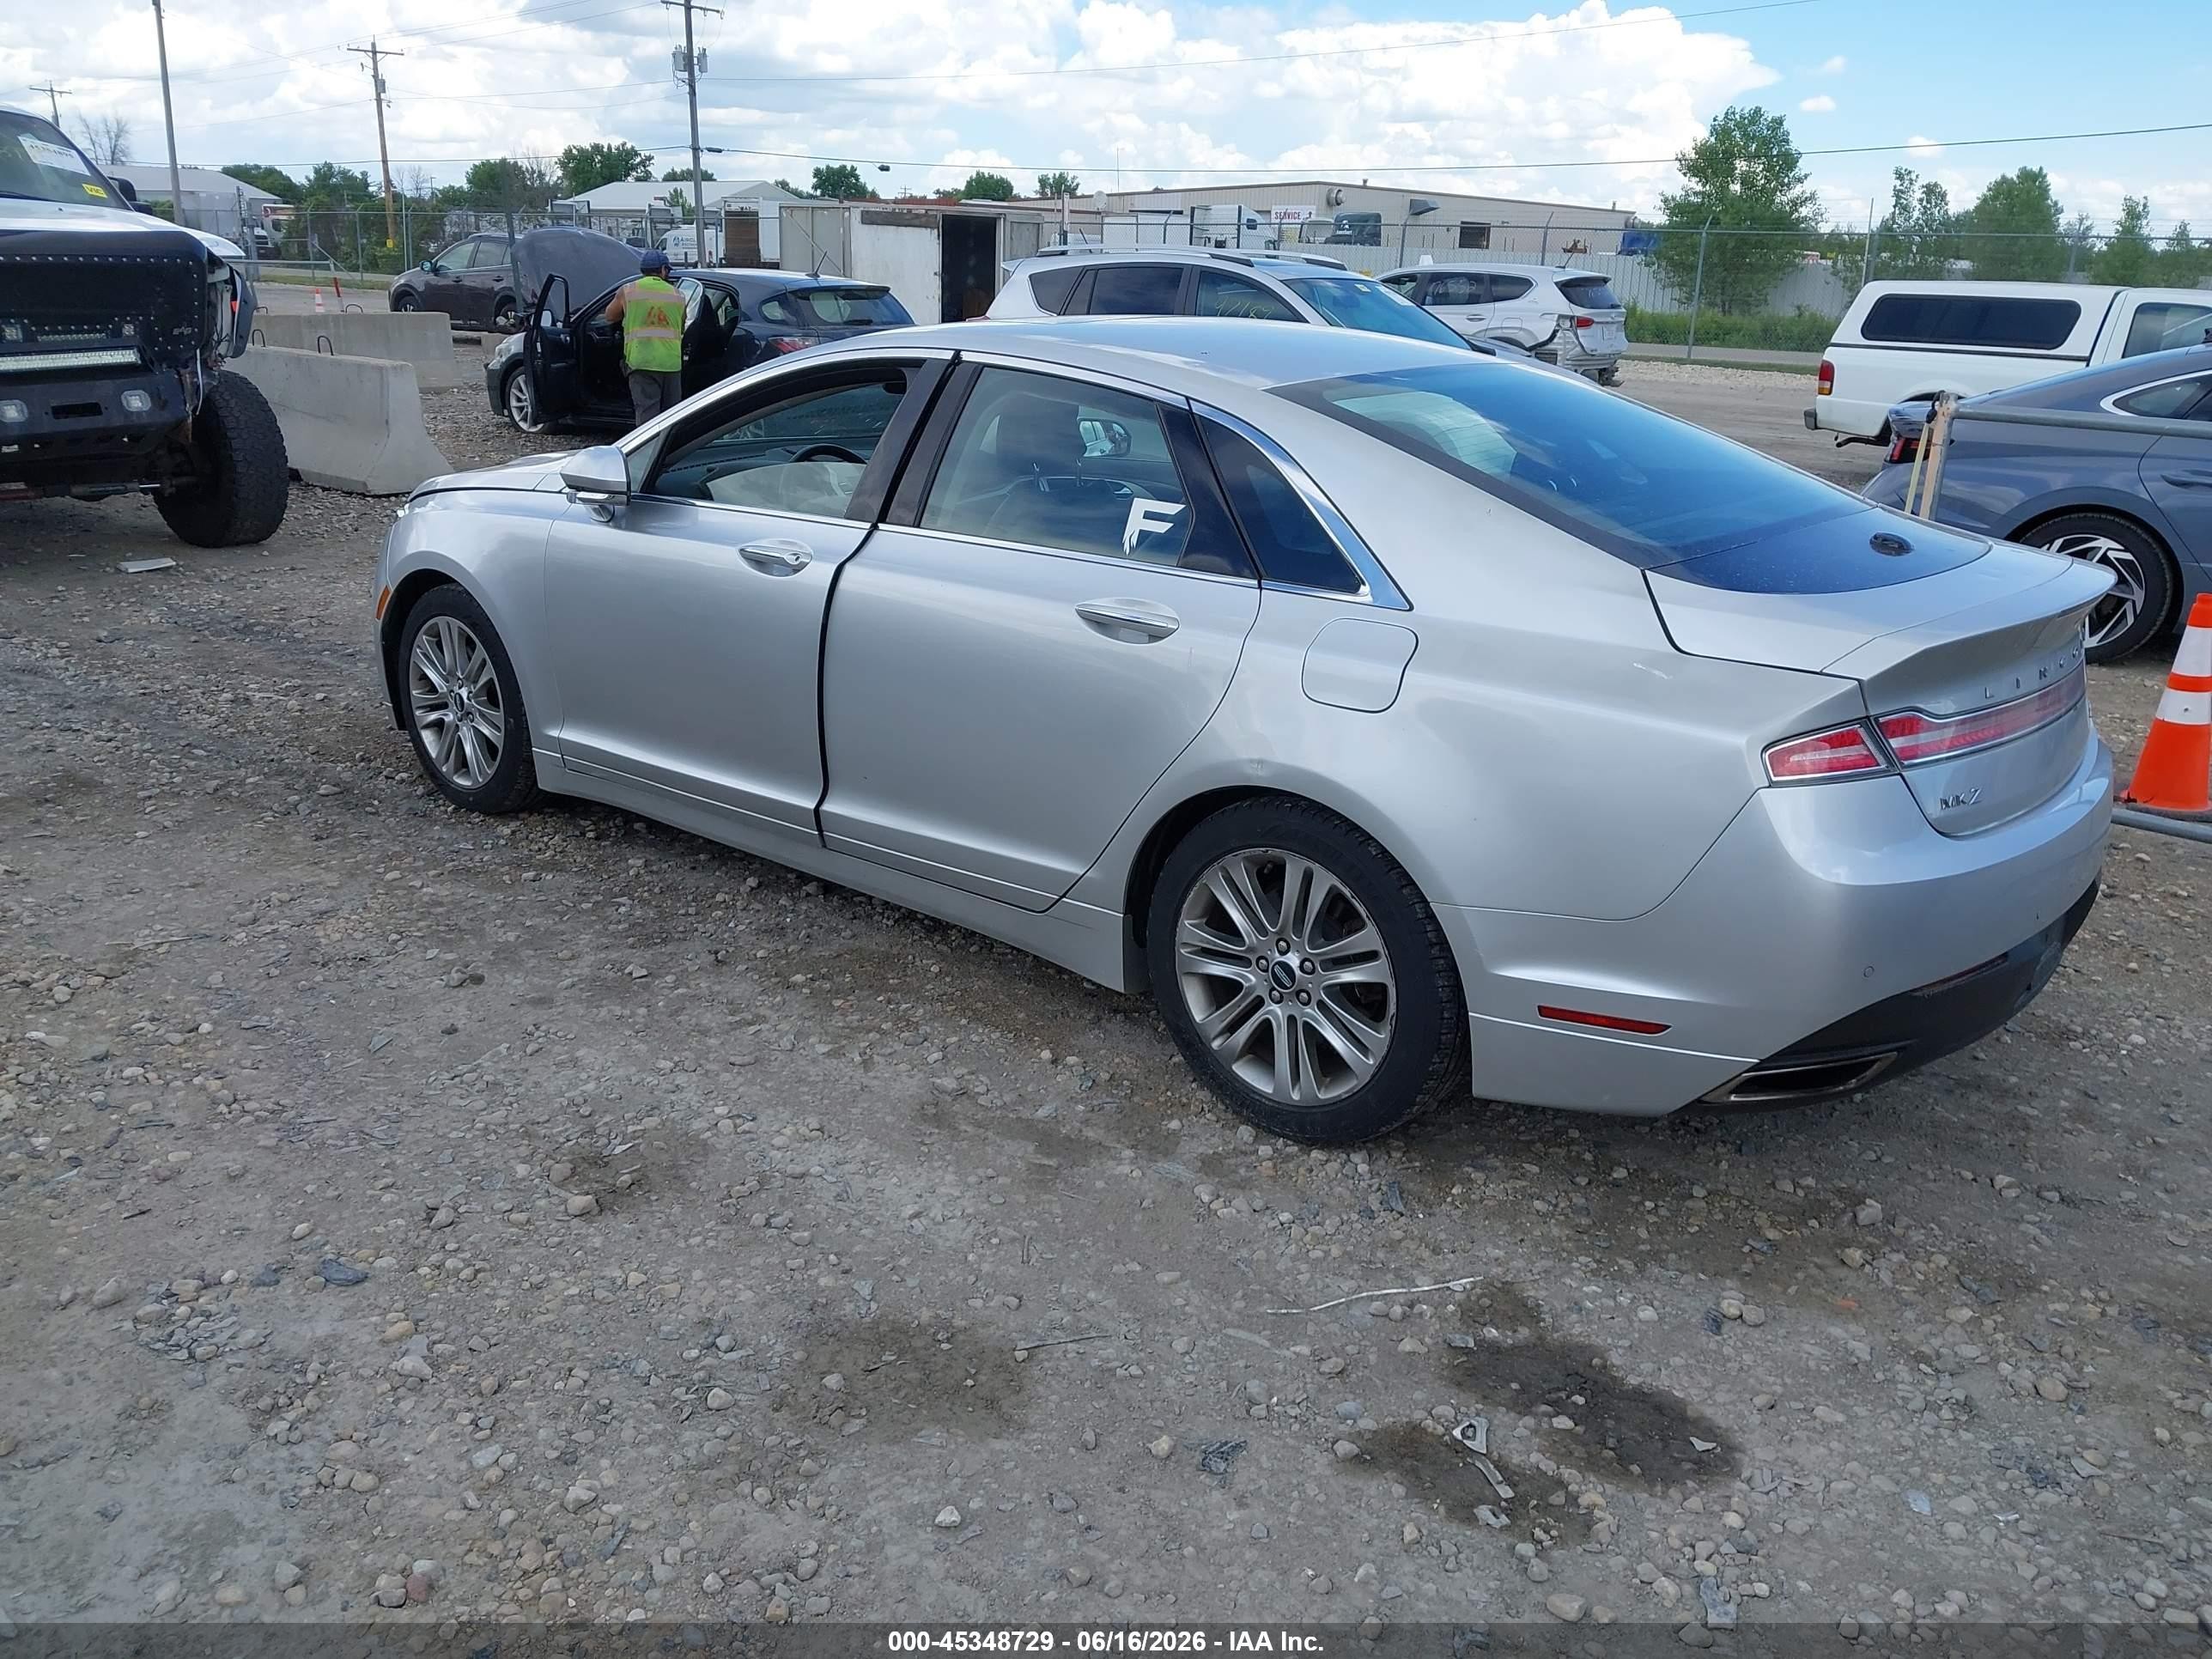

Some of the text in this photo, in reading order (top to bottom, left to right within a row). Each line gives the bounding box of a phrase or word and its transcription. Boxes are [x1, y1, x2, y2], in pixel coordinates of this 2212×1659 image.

[1274, 211, 1301, 221] SERVICE
[1122, 497, 1187, 556] F
[1940, 788, 1983, 810] MKZ
